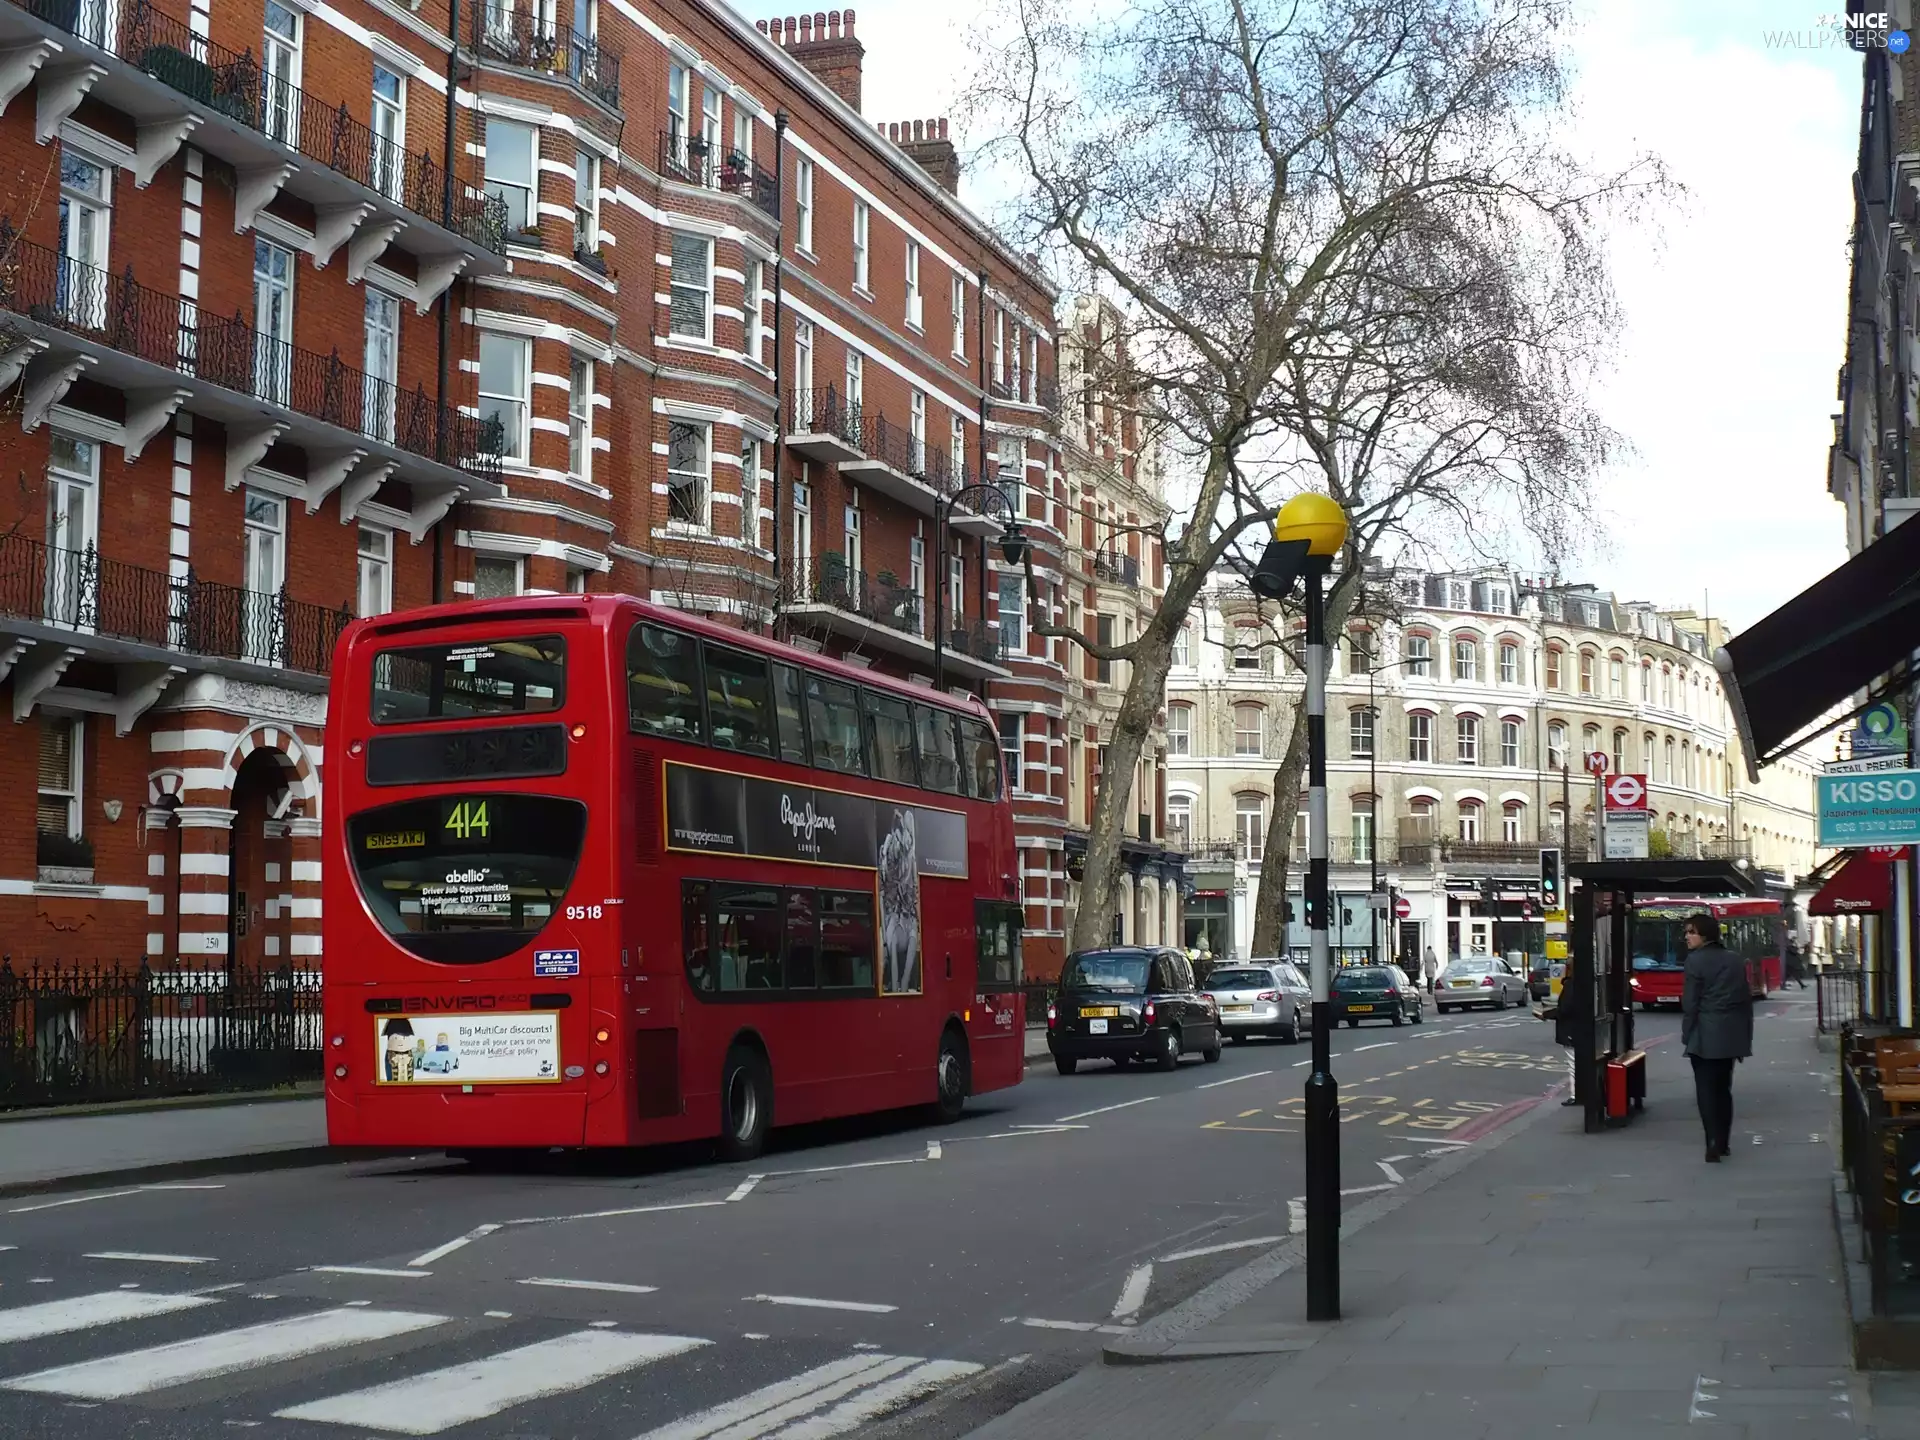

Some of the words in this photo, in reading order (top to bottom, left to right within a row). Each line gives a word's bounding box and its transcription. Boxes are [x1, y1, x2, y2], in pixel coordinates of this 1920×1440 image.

[1589, 755, 1606, 771] M
[1830, 779, 1916, 804] KISSO
[445, 800, 489, 838] 414
[781, 794, 806, 838] Pepe
[445, 869, 485, 883] abellio
[422, 887, 444, 896] Driver
[459, 883, 509, 894] Opportunities
[566, 905, 603, 920] 9518
[206, 937, 220, 949] 250
[404, 995, 496, 1010] ENVIRO
[459, 1026, 473, 1037] Big
[474, 1025, 508, 1035] MultiCar
[509, 1024, 553, 1034] discounts!
[492, 1039, 507, 1047] your
